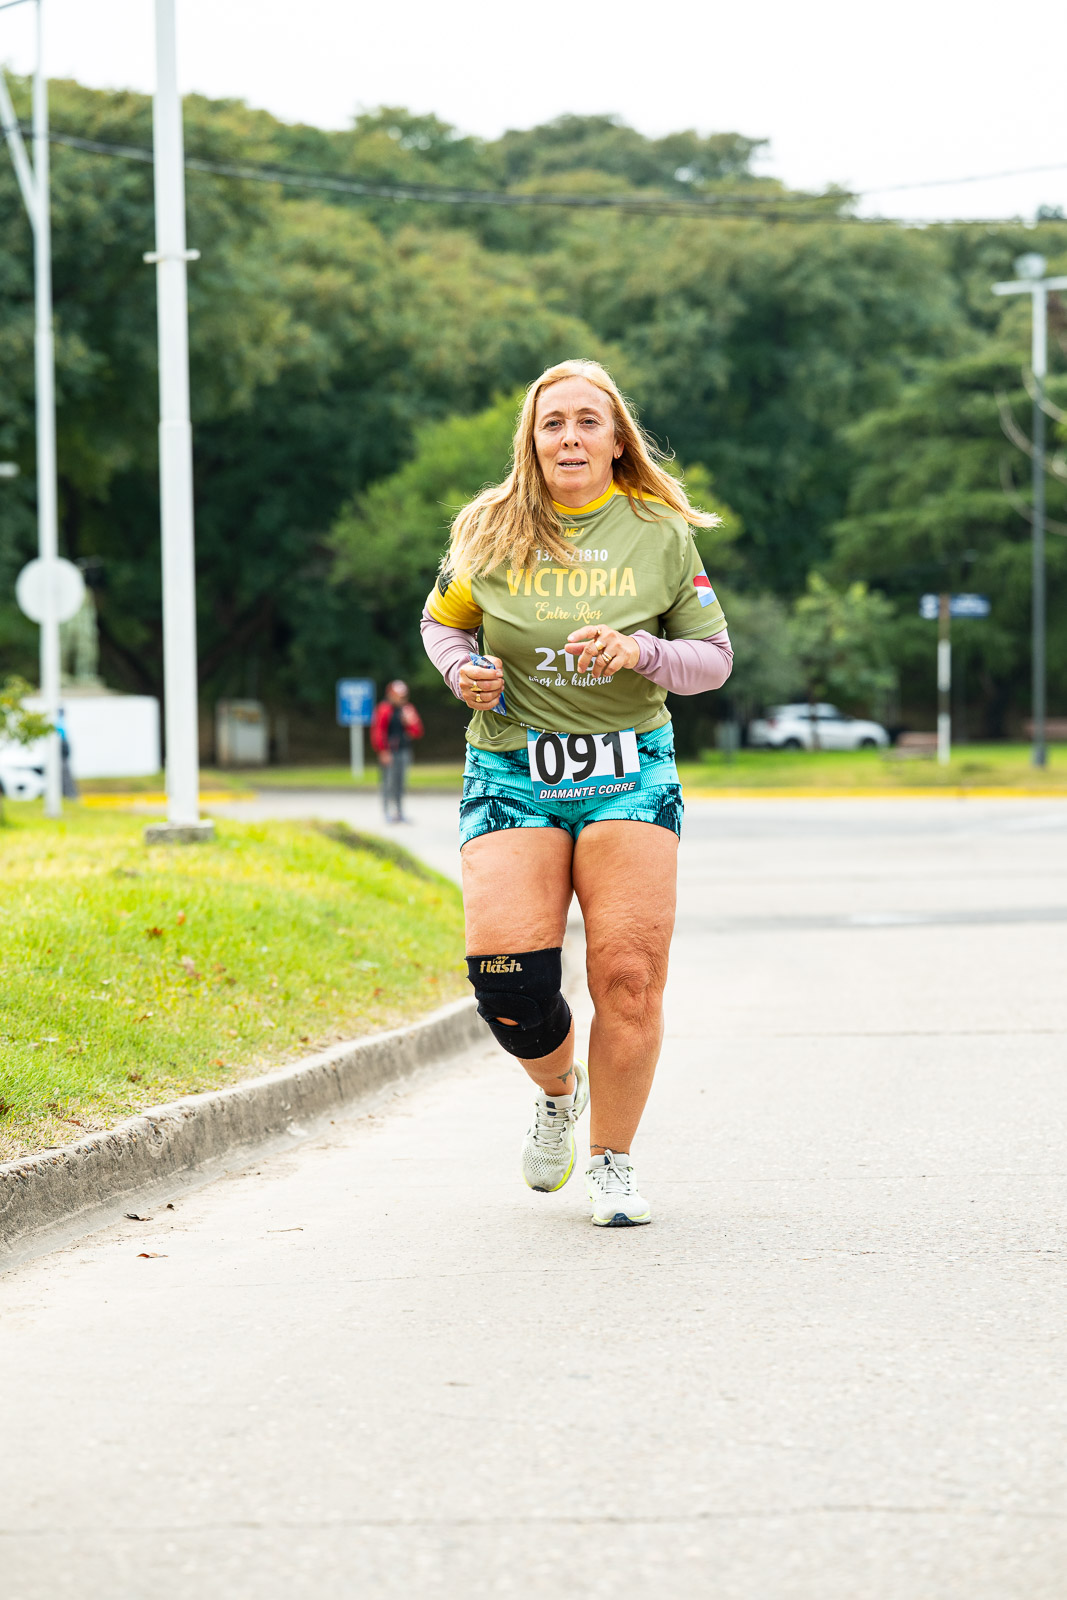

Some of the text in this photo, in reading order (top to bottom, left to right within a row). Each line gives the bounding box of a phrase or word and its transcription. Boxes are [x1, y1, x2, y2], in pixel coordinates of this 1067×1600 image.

[535, 549, 608, 562] 13//1810
[506, 567, 637, 597] VICTORIA
[535, 601, 571, 622] Entre
[554, 672, 568, 686] de
[535, 731, 625, 786] 091
[539, 781, 636, 799] DIAMANTE CORRE
[480, 959, 523, 973] flash
